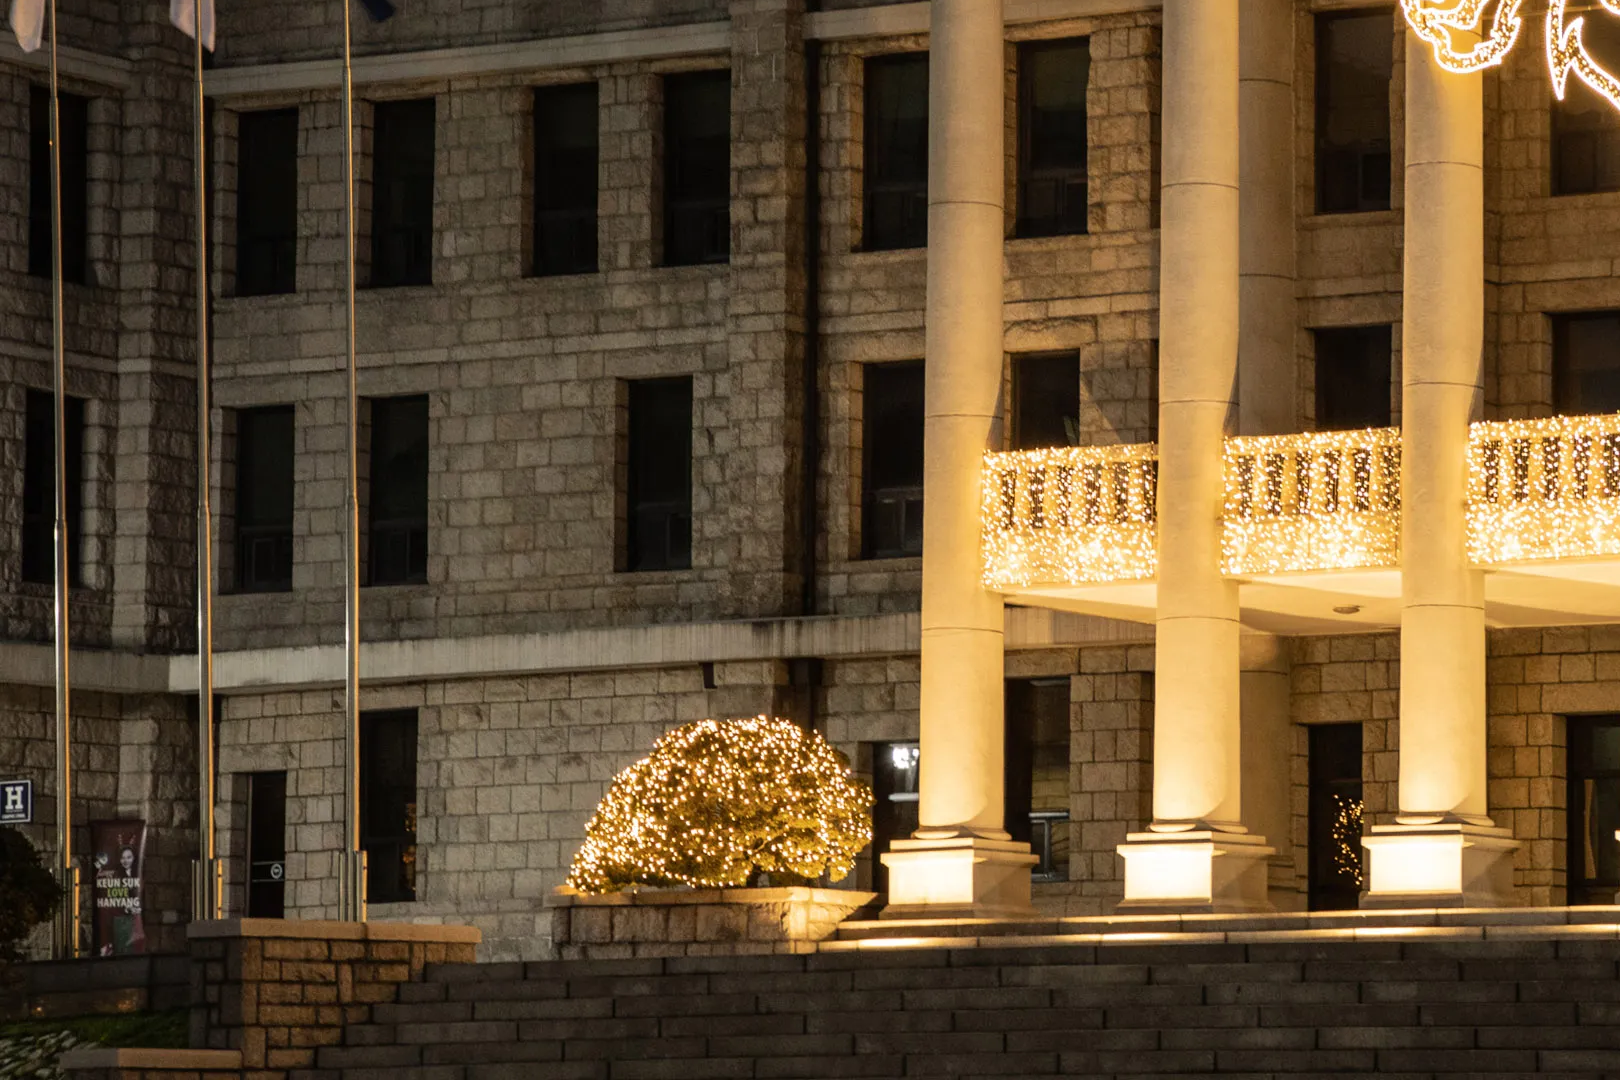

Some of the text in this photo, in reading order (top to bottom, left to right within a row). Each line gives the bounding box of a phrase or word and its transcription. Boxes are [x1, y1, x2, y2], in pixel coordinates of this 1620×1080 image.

[5, 786, 24, 809] H
[96, 877, 120, 888] KEUN
[107, 887, 129, 898] LOVE
[97, 897, 140, 908] HANYANG
